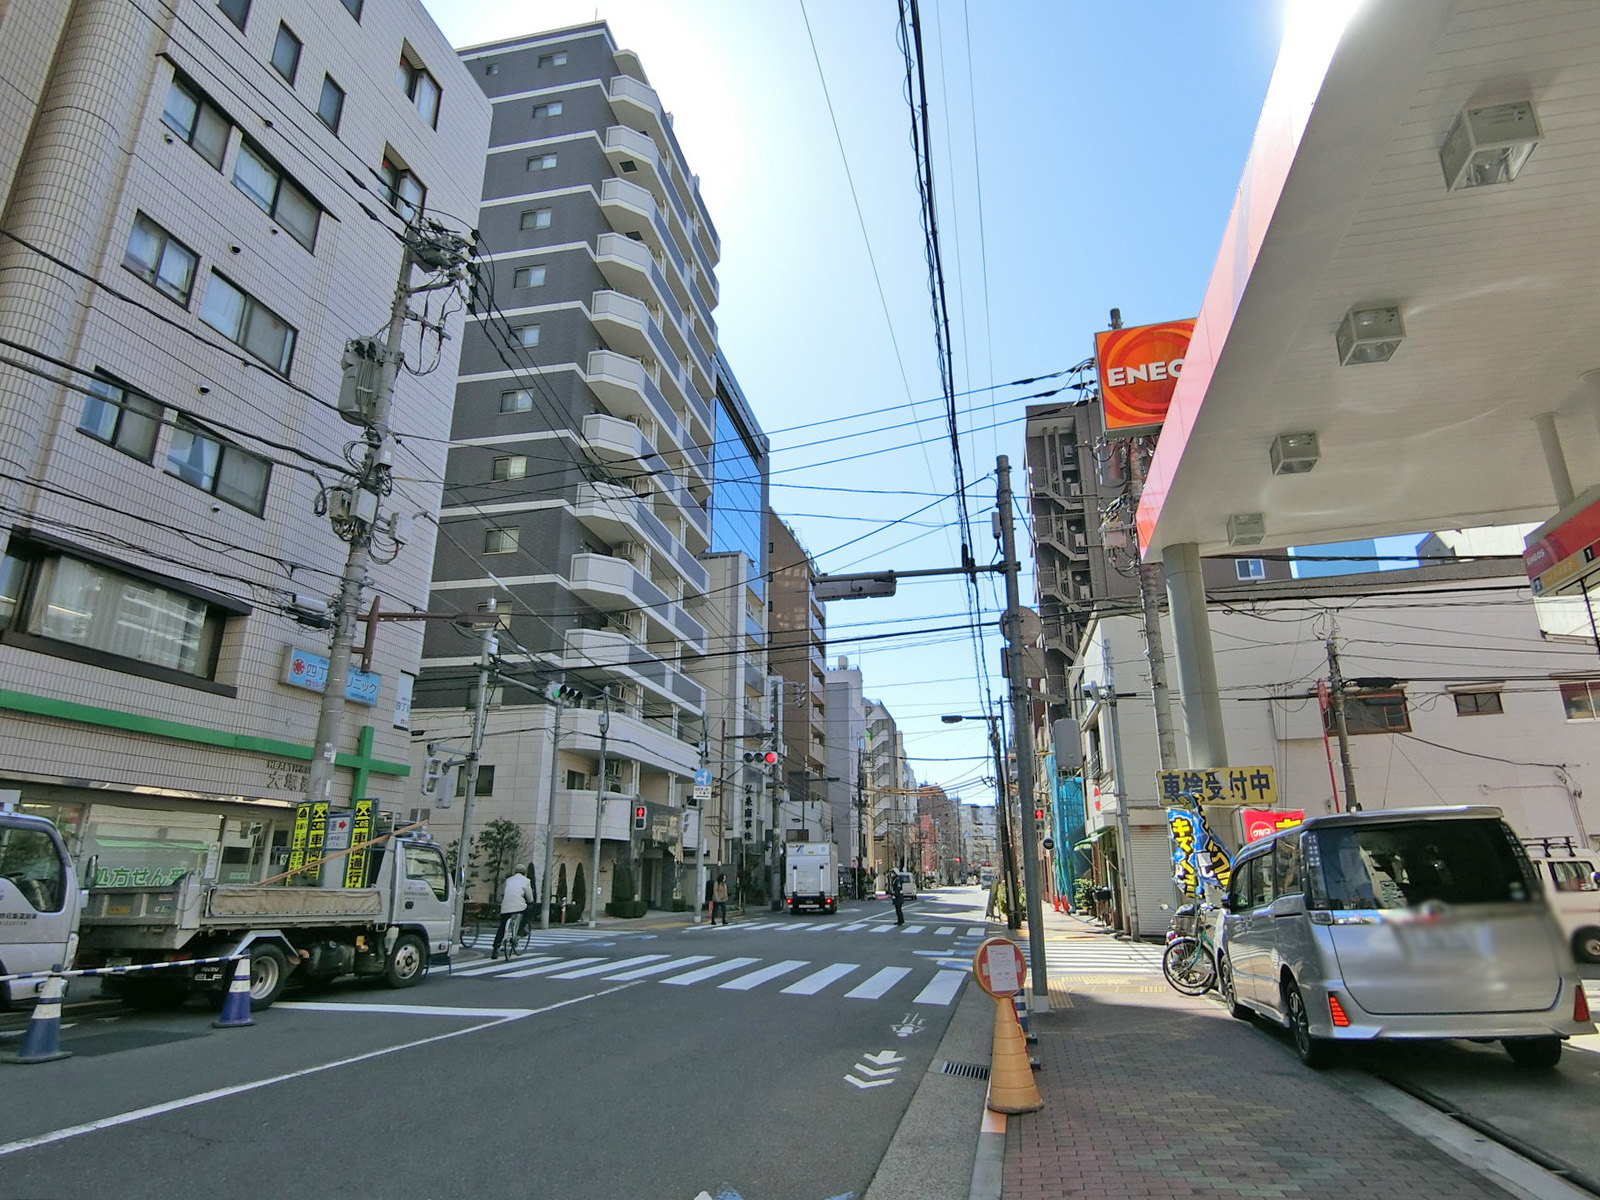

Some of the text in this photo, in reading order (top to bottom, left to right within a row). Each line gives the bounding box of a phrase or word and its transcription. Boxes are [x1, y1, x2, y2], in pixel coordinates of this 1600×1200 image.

[1107, 358, 1185, 387] ENEO
[1526, 548, 1545, 566] ENEOS
[1161, 769, 1270, 802] 車検受付中
[348, 832, 368, 888] 車両通行
[194, 973, 223, 982] ELF
